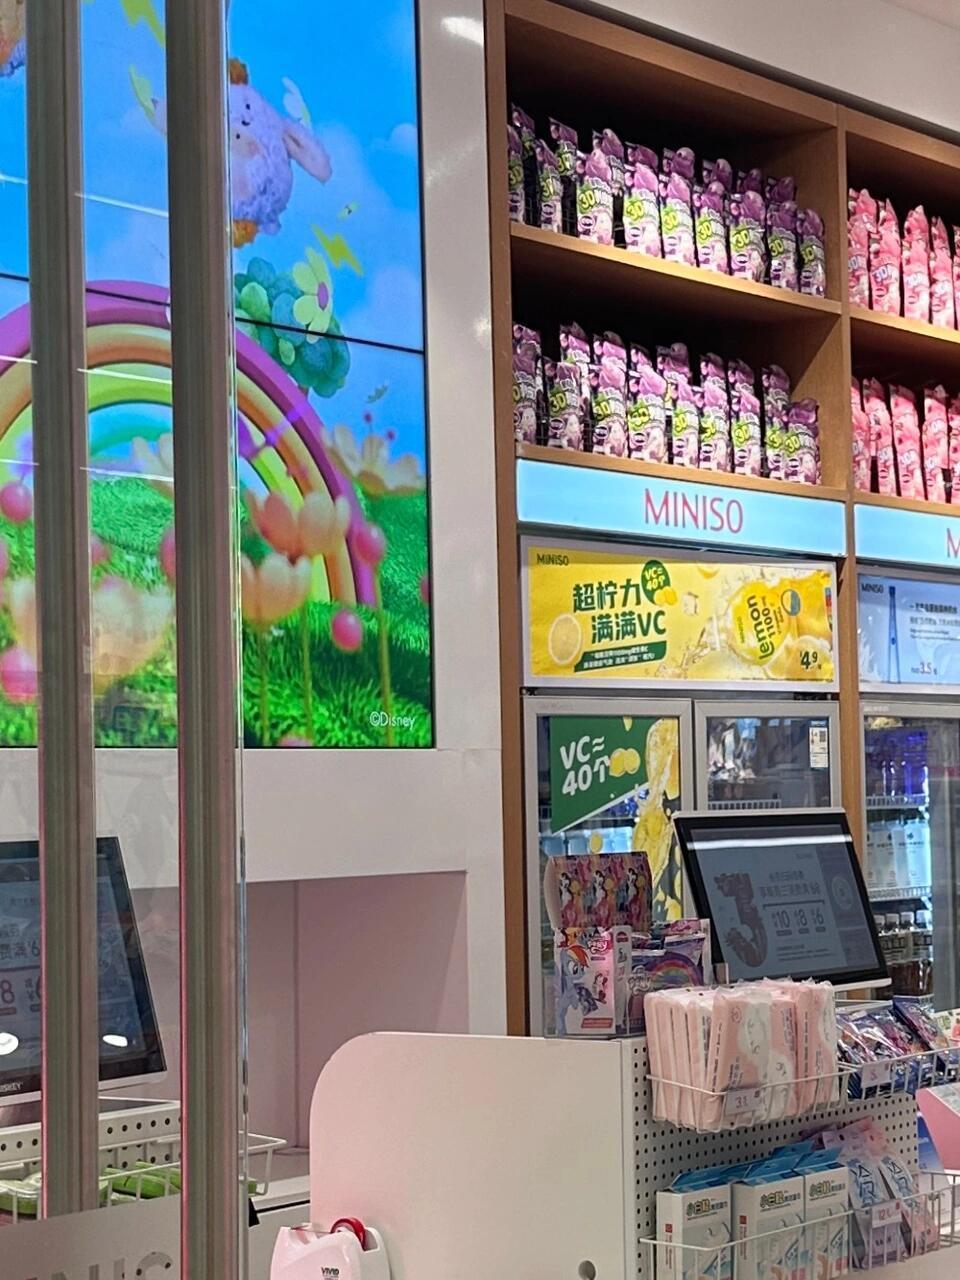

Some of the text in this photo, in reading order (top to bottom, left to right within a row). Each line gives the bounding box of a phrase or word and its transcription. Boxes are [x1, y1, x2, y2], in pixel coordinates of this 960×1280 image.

[644, 488, 743, 533] MINISO
[536, 553, 569, 566] MINISO
[573, 578, 641, 613] 超柠力
[591, 610, 667, 645] 满满VC
[747, 595, 775, 660] lemon
